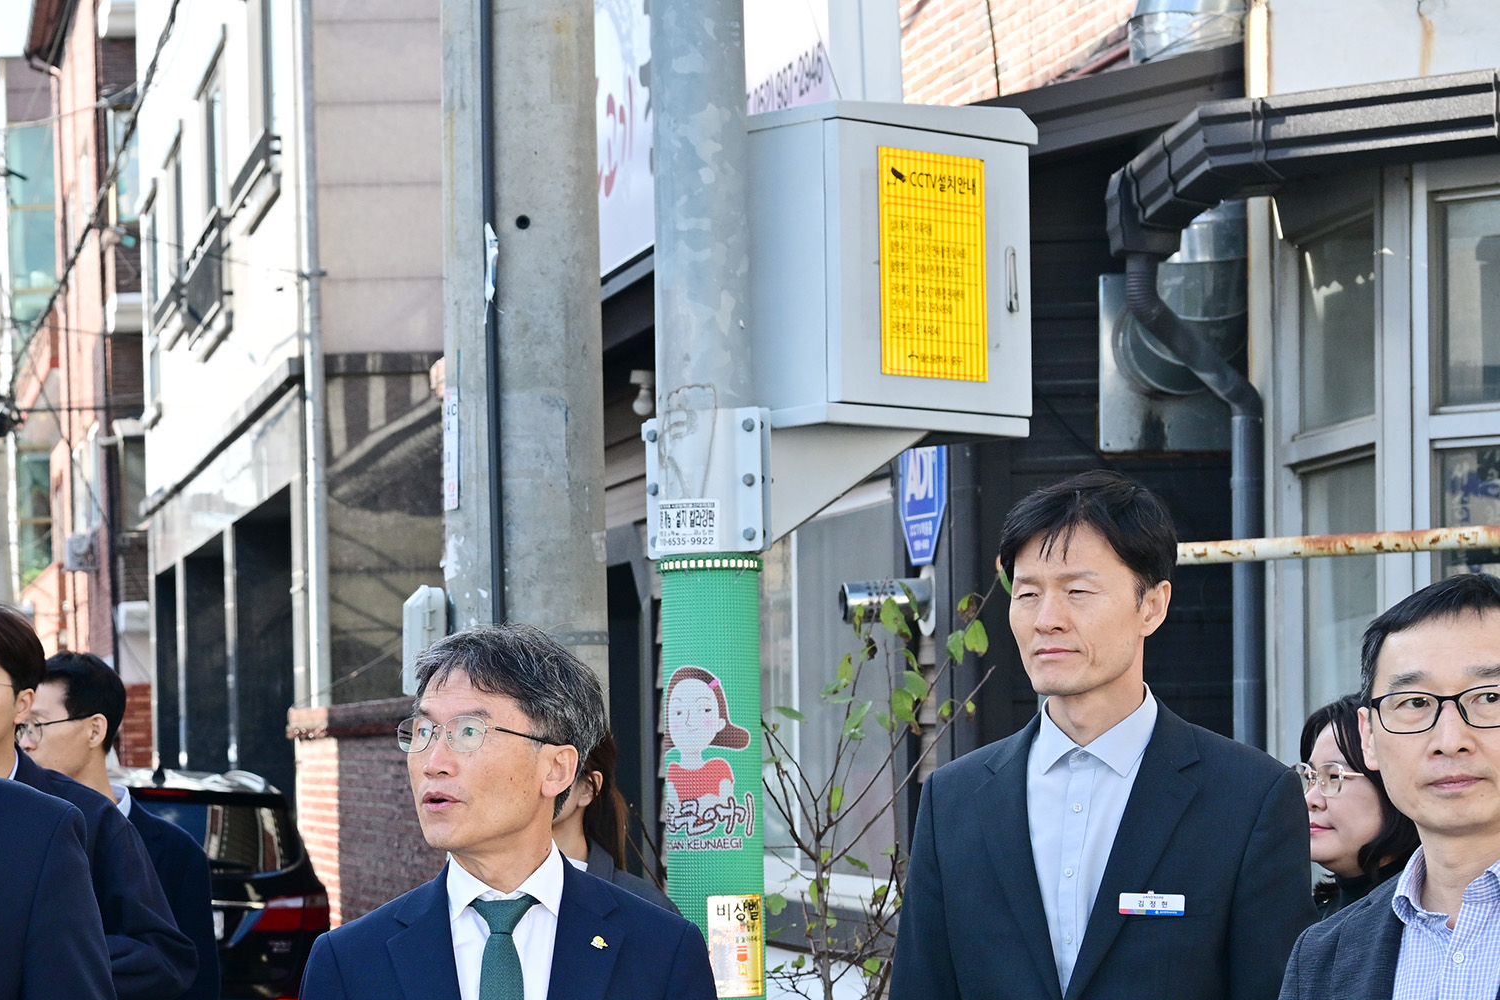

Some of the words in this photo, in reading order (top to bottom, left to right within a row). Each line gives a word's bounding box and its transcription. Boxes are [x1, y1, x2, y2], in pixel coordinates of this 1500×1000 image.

[908, 171, 976, 196] CCTV설치안내
[906, 447, 935, 502] ADT
[687, 838, 742, 850] KEUNAEGI
[716, 901, 759, 921] 비상벨
